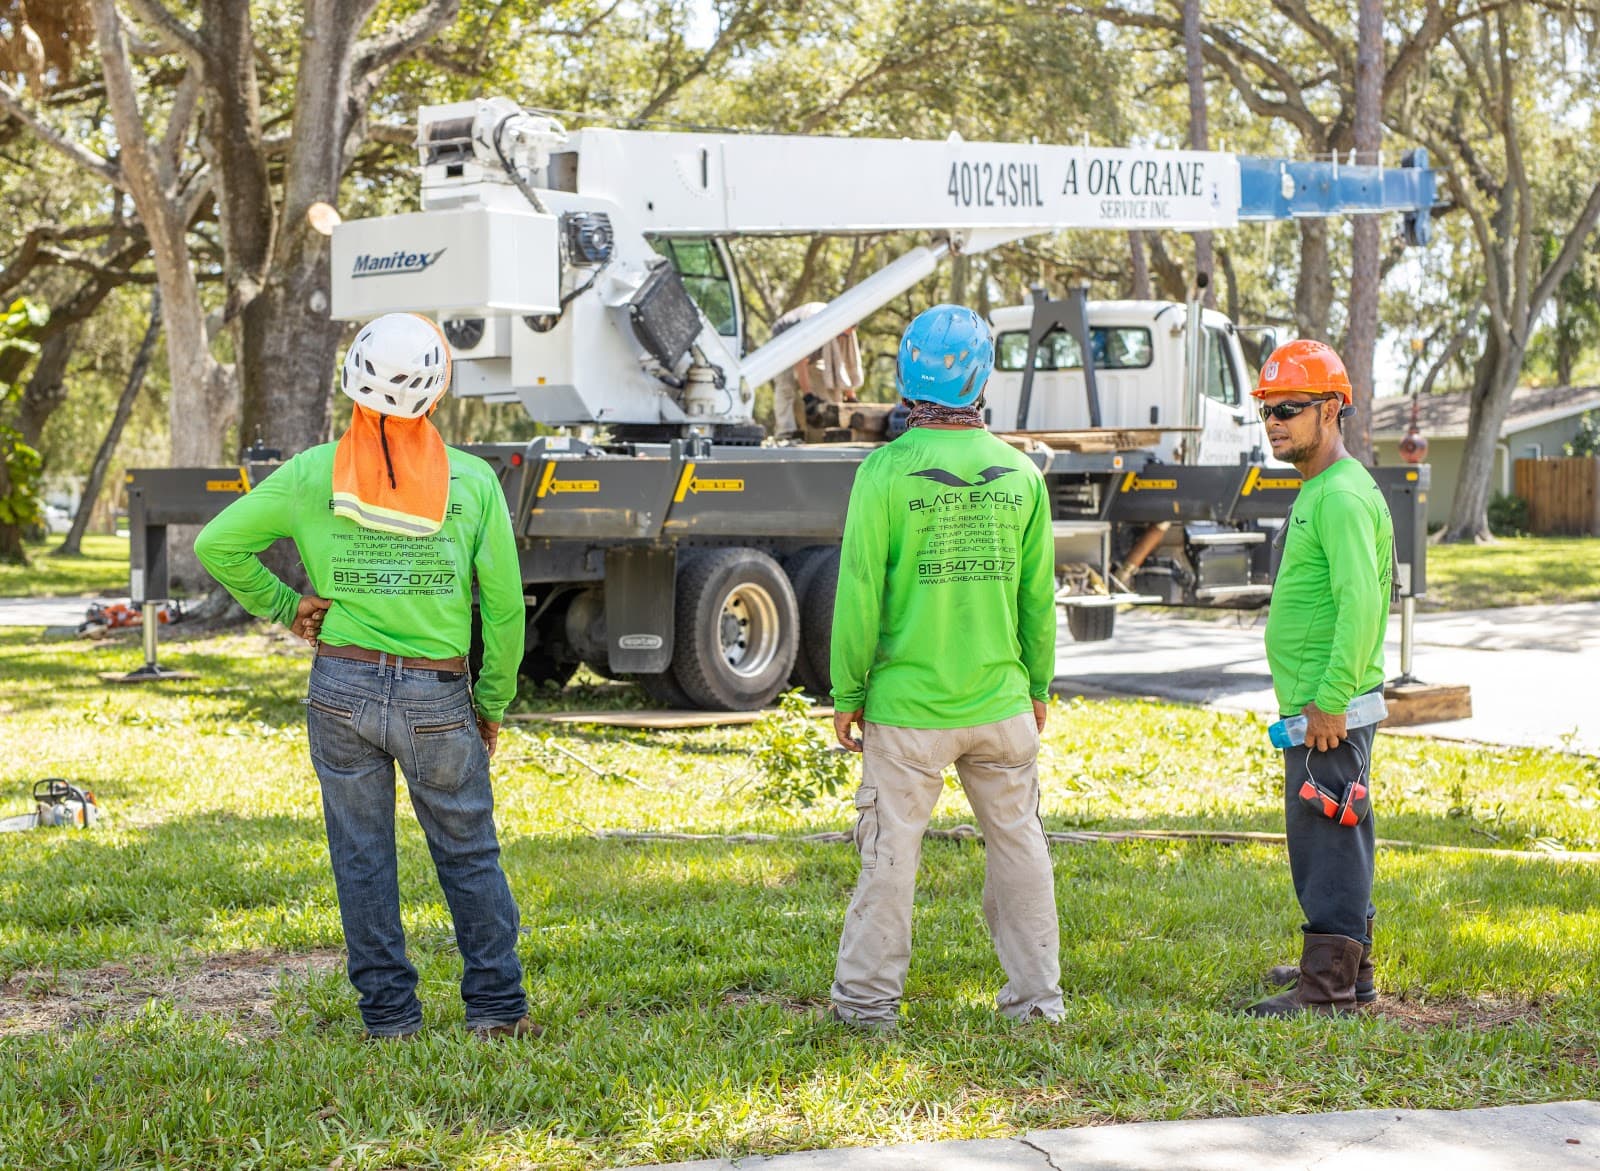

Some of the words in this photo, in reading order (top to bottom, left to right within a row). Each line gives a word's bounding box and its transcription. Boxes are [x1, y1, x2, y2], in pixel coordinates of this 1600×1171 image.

[1063, 158, 1079, 195] A
[1088, 159, 1122, 195] OK
[1130, 160, 1204, 196] CRANE
[948, 162, 1043, 207] 40124SHL
[1100, 200, 1147, 219] SERVICE
[353, 251, 430, 272] Manitex
[909, 492, 963, 511] BLACK
[969, 491, 1023, 506] EAGLE
[332, 533, 355, 541] TREE
[357, 534, 404, 542] TRIMMING
[415, 535, 456, 543] PRUNING
[929, 538, 967, 548] CERFIED
[353, 542, 388, 550] STUMP
[346, 549, 392, 557] CERTIFIED
[358, 557, 413, 566] EMERGENCY
[333, 571, 456, 585] 813-547-0747
[334, 586, 454, 595] WWW.BLACKEAGLETREE.COM
